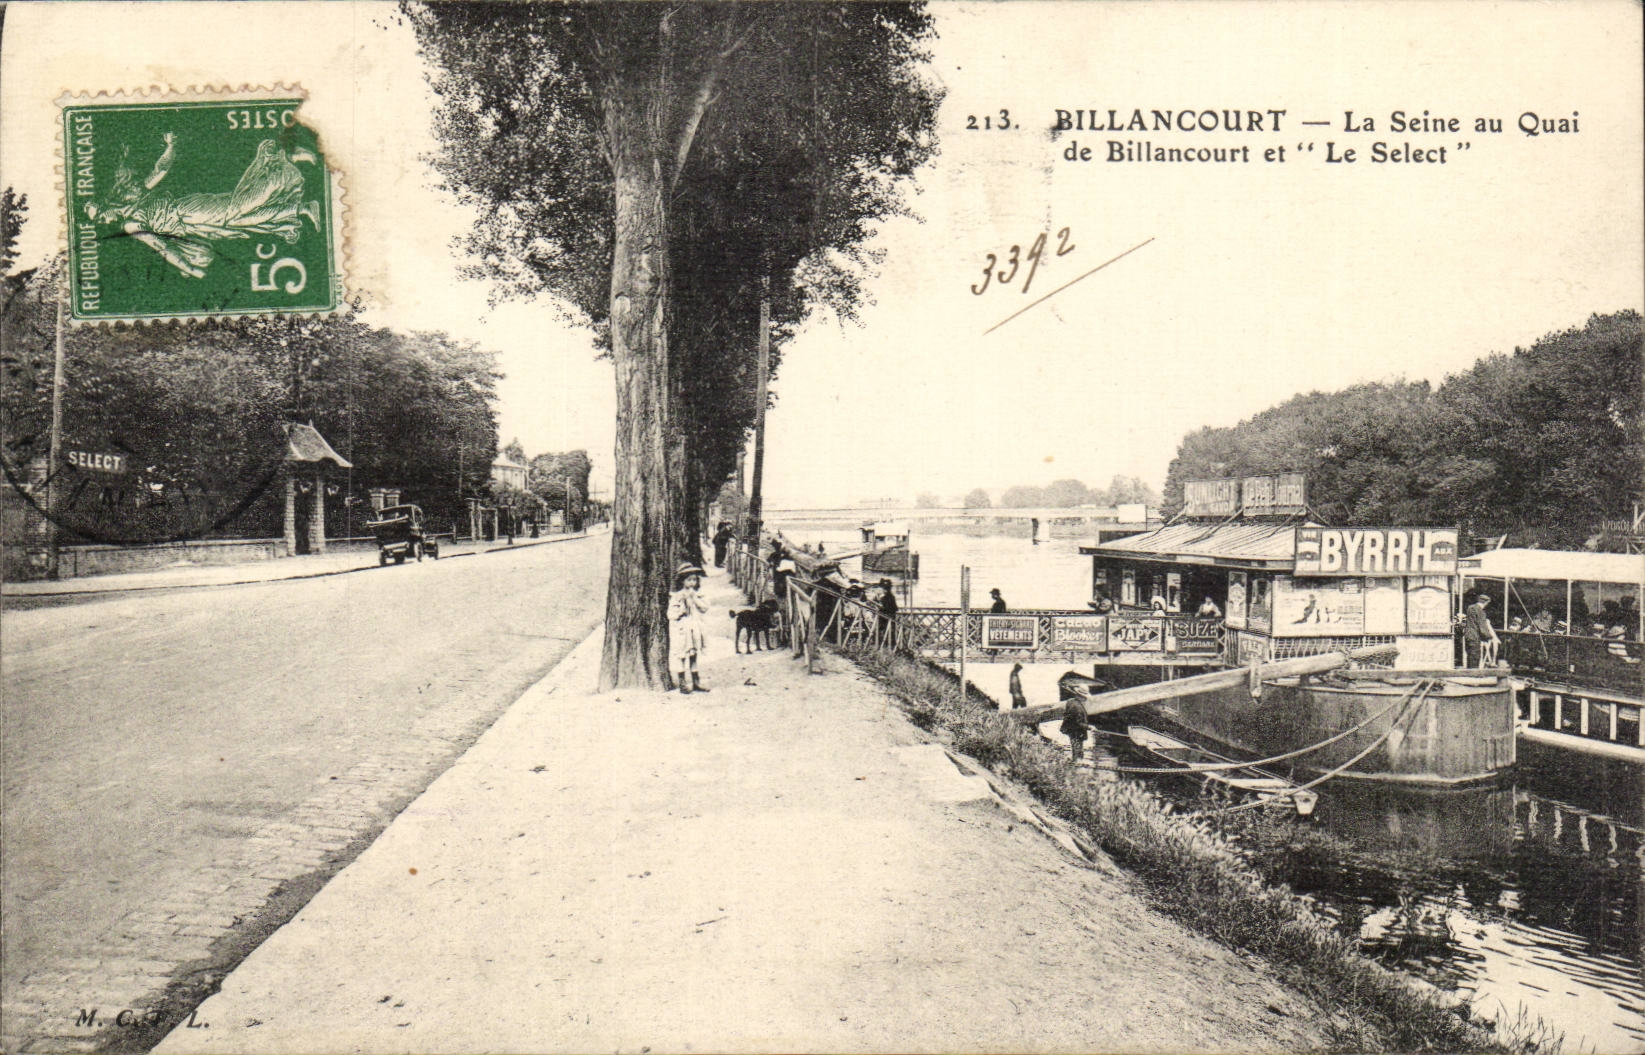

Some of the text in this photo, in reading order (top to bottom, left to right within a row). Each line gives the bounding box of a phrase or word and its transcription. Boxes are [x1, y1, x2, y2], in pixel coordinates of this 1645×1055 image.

[227, 109, 297, 130] OSTES
[75, 114, 97, 196] FRANÇAISE
[68, 450, 121, 470] SELECT
[1320, 530, 1433, 573] BYRRH
[1117, 628, 1152, 641] JAPY
[1174, 621, 1218, 639] SUZE
